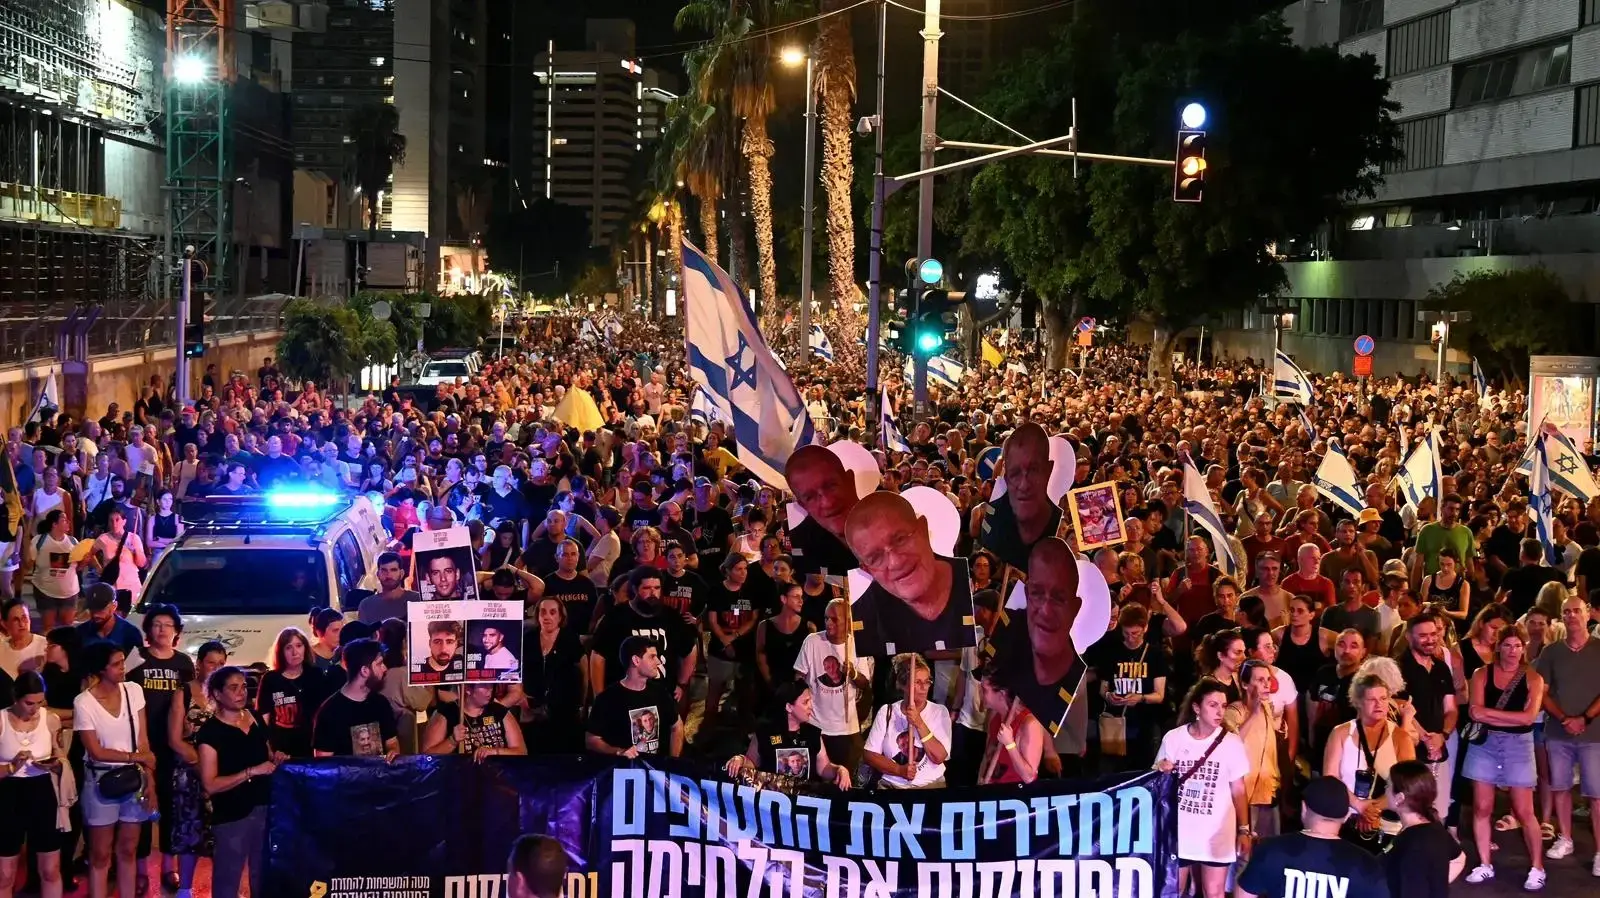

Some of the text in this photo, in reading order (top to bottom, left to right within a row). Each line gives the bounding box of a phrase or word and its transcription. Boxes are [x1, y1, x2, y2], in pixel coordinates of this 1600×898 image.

[612, 768, 1153, 860] מחזירים את החטופים
[411, 876, 430, 888] מטה
[611, 838, 805, 898] הלחימה
[823, 855, 899, 898] את
[331, 876, 364, 891] להחזרת
[366, 876, 409, 890] המשפחות
